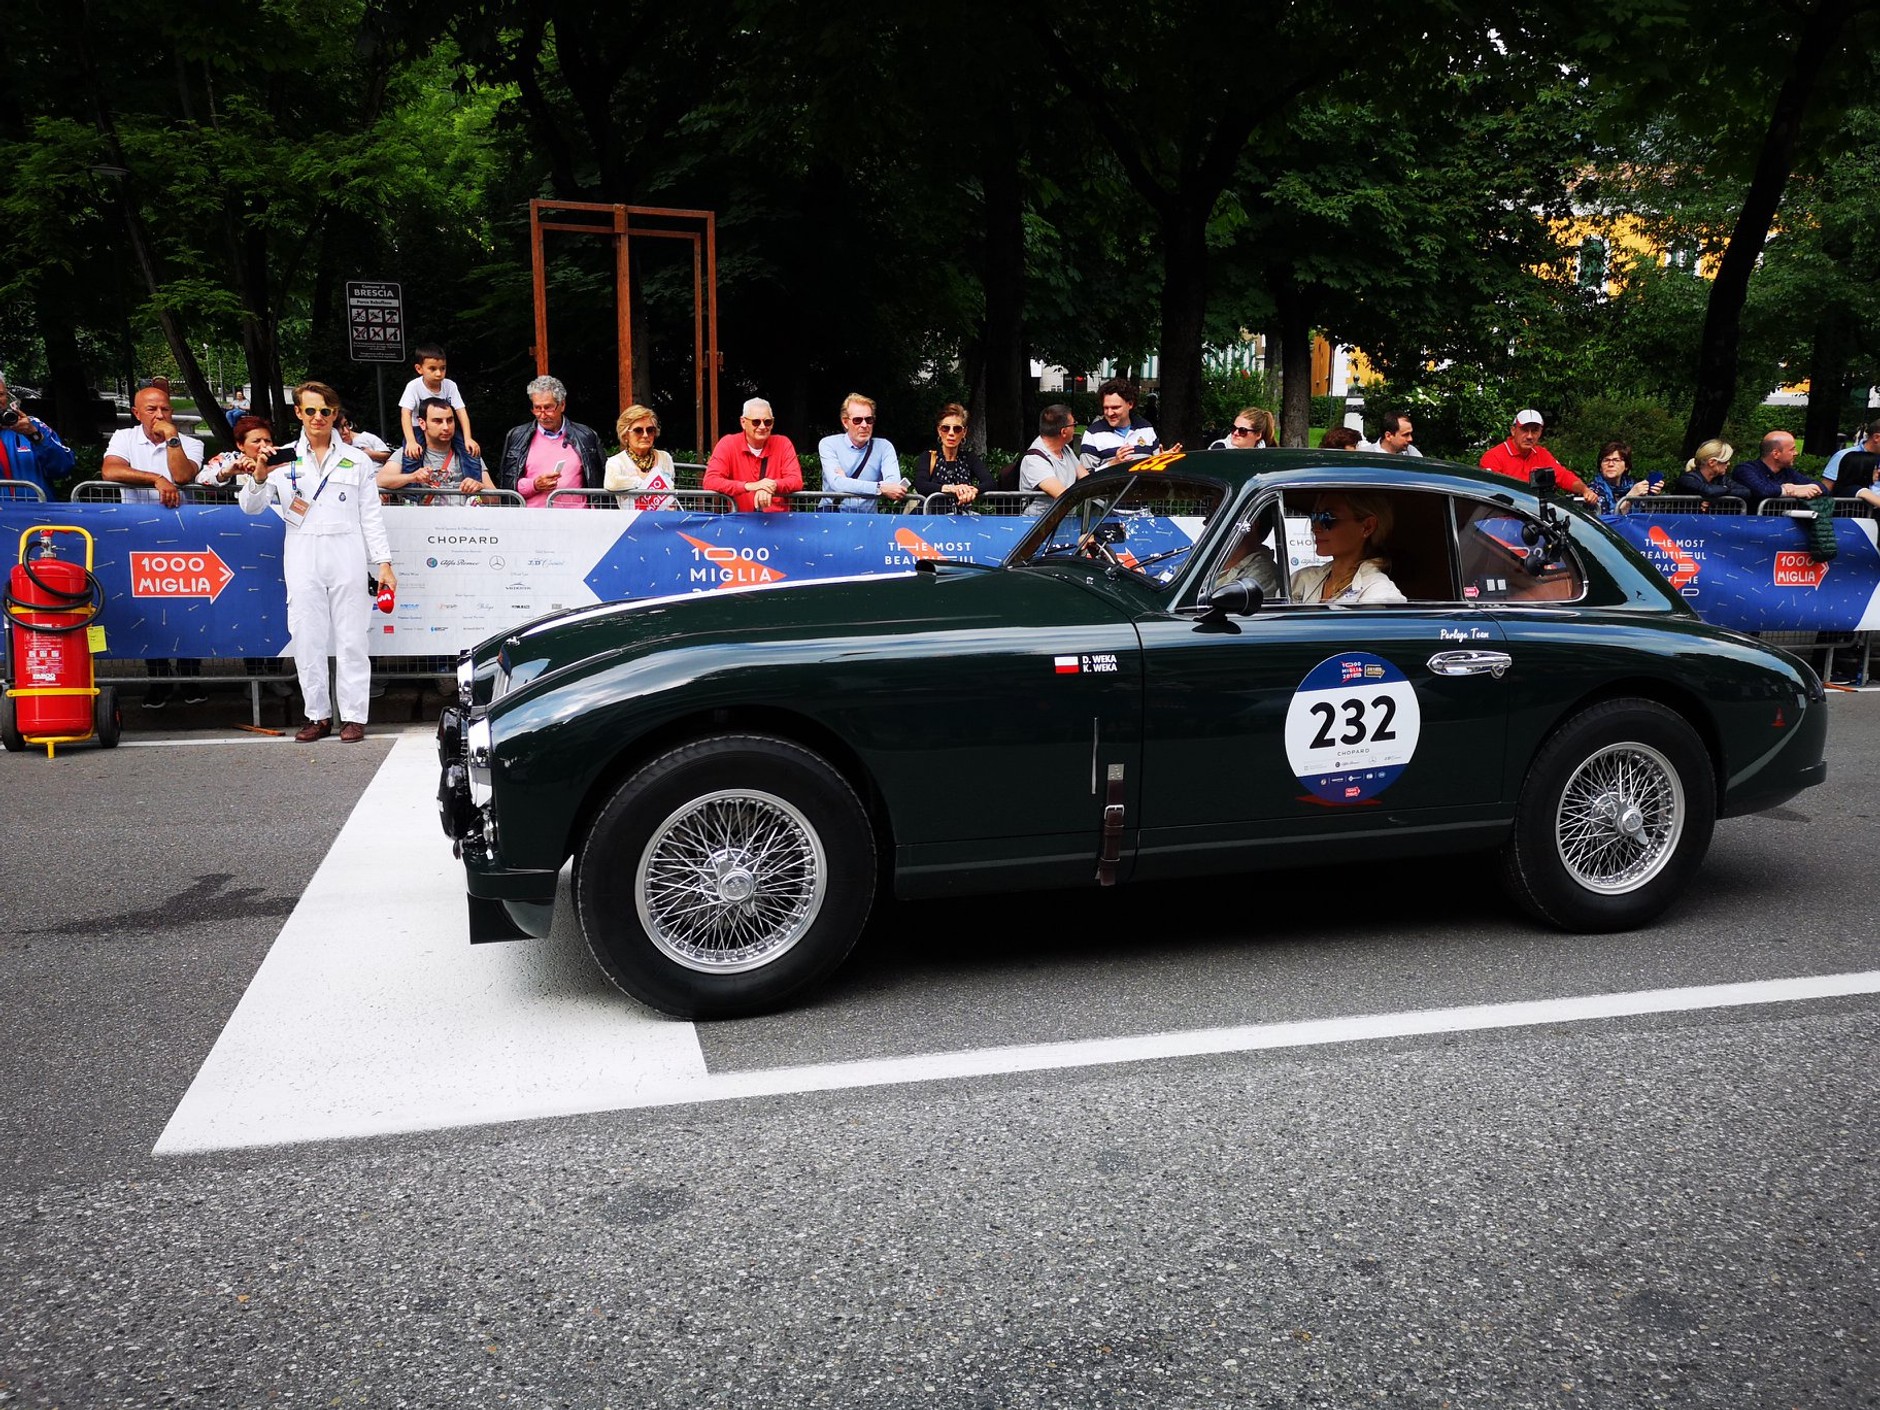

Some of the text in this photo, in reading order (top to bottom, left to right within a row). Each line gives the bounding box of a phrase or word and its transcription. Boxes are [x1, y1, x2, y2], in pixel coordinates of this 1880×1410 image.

[354, 289, 394, 298] BRESCIA
[427, 535, 499, 545] CHOPARD
[1645, 539, 1705, 549] THE MOST
[888, 542, 971, 551] THE MOST
[691, 547, 770, 561] 1000
[140, 557, 205, 573] 1000
[690, 568, 773, 582] MIGLIA
[1777, 571, 1815, 583] MIGLIA
[138, 577, 211, 593] MIGLIA
[1082, 655, 1117, 664] D. WEKA
[1083, 664, 1118, 673] K. WEKA
[1309, 695, 1396, 750] 232
[1337, 748, 1370, 757] CHOPARD
